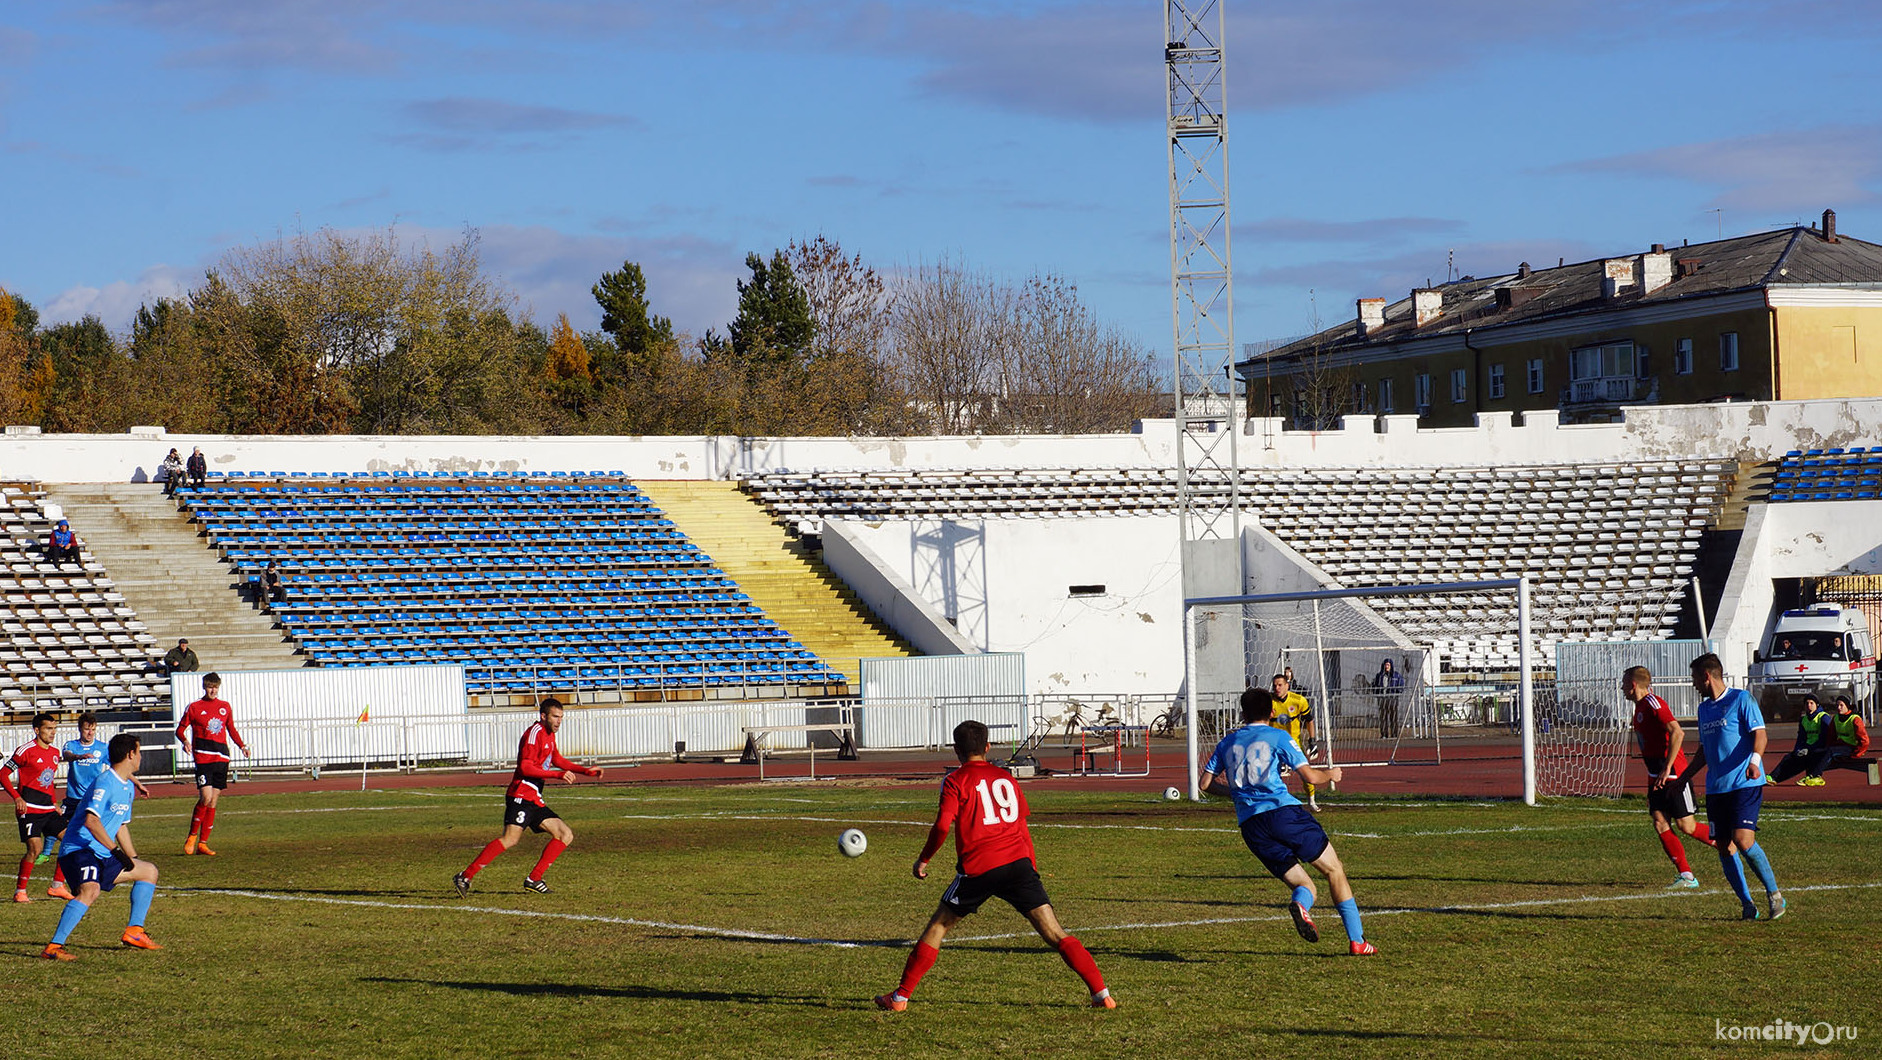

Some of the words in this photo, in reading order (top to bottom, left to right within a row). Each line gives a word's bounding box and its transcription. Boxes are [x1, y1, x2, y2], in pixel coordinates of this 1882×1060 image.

[975, 778, 1019, 825] 19
[515, 810, 526, 824] 3
[25, 822, 33, 836] 7
